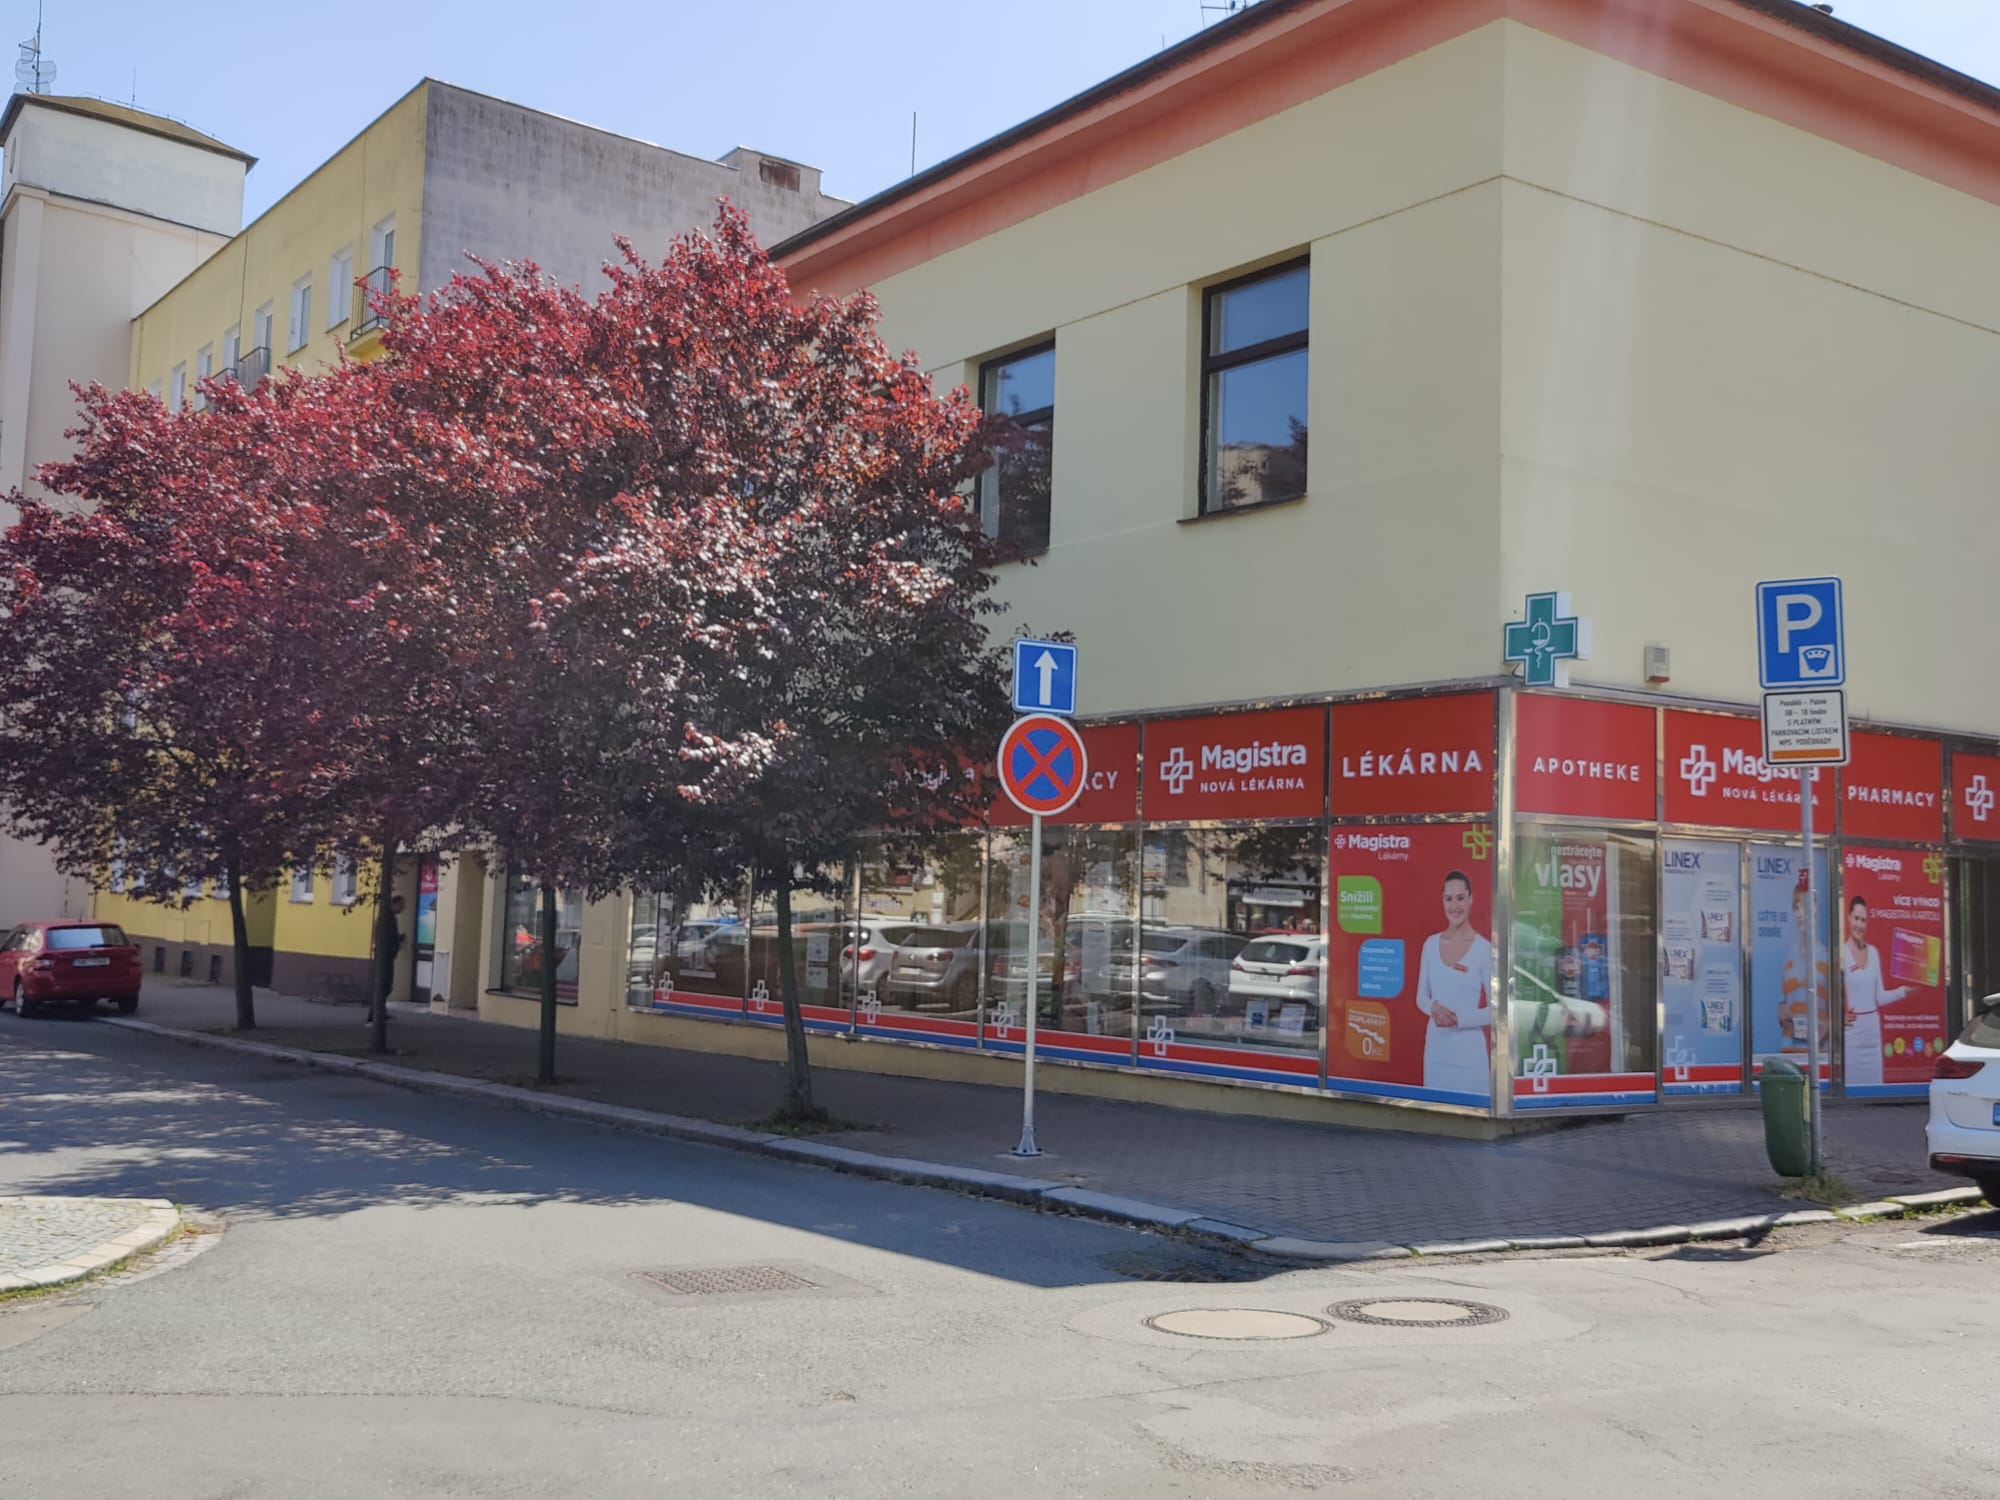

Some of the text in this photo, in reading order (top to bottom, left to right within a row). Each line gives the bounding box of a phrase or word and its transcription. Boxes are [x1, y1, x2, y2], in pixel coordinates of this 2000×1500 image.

[1776, 594, 1822, 653] P
[1201, 740, 1307, 773] Magistra
[1342, 747, 1482, 778] LÉKÁRNA
[1533, 757, 1640, 782] APOTHEKE
[1201, 776, 1304, 793] NOVÁ LÉKÁRNA
[1722, 786, 1819, 806] NOVÁ LÉKÁRA
[1847, 785, 1934, 807] PHARMACY
[1348, 833, 1409, 851] Magistra
[1664, 851, 1701, 869] LINEX
[1757, 857, 1791, 874] LINEX
[1855, 855, 1901, 872] Magistra
[1534, 855, 1602, 897] vlasy
